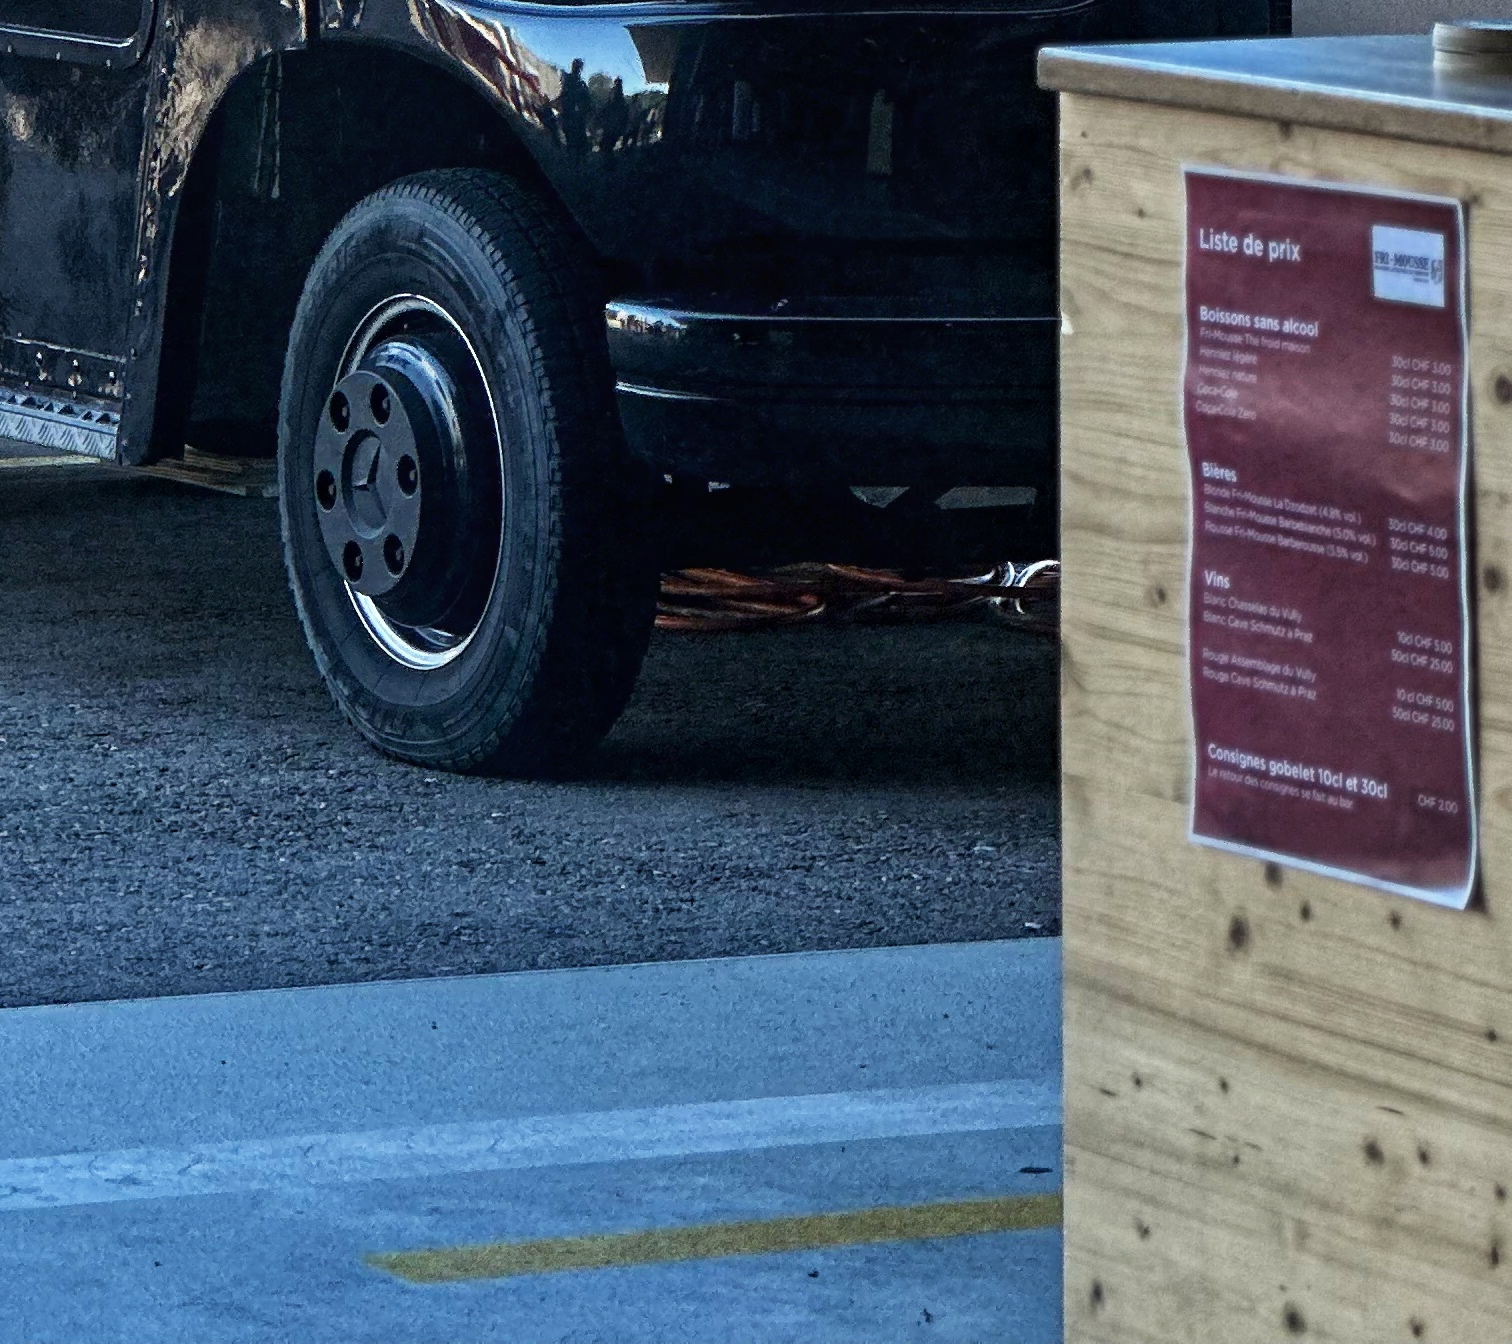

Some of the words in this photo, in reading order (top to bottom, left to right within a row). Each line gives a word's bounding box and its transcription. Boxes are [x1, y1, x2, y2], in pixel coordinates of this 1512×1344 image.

[1199, 227, 1238, 253] Liste
[1243, 232, 1264, 257] de
[1268, 238, 1301, 263] prix
[1374, 250, 1429, 271] FRI-MOUSSE
[1199, 305, 1251, 328] Boissons
[1253, 315, 1280, 332] sans
[1282, 317, 1319, 337] alcool
[1411, 358, 1431, 372] CHF
[1432, 362, 1452, 376] 3.00
[1411, 377, 1430, 390] CHF
[1431, 380, 1451, 395] 3.00
[1411, 396, 1429, 410] CHF
[1431, 399, 1450, 415] 3.00
[1410, 415, 1429, 428] CHF
[1431, 419, 1450, 434] 3.00
[1409, 435, 1428, 448] CHF
[1429, 438, 1449, 452] 3.00
[1201, 462, 1236, 482] Bières
[1407, 521, 1426, 535] CHF
[1427, 525, 1448, 541] 4.00
[1409, 541, 1427, 555] CHF
[1410, 560, 1428, 574] CHF
[1204, 569, 1230, 589] Vins
[1415, 634, 1433, 649] CHF
[1434, 639, 1453, 654] 5.00
[1410, 653, 1428, 667] CHF
[1416, 692, 1433, 706] CHF
[1435, 697, 1454, 713] 5.00
[1411, 710, 1430, 724] CHF
[1207, 742, 1266, 771] Consignes
[1269, 759, 1316, 783] gobelet
[1318, 768, 1343, 789] 10cl
[1345, 776, 1358, 793] et
[1360, 778, 1388, 799] 30cl
[1417, 793, 1436, 808] CHF
[1438, 798, 1458, 814] 2.00
